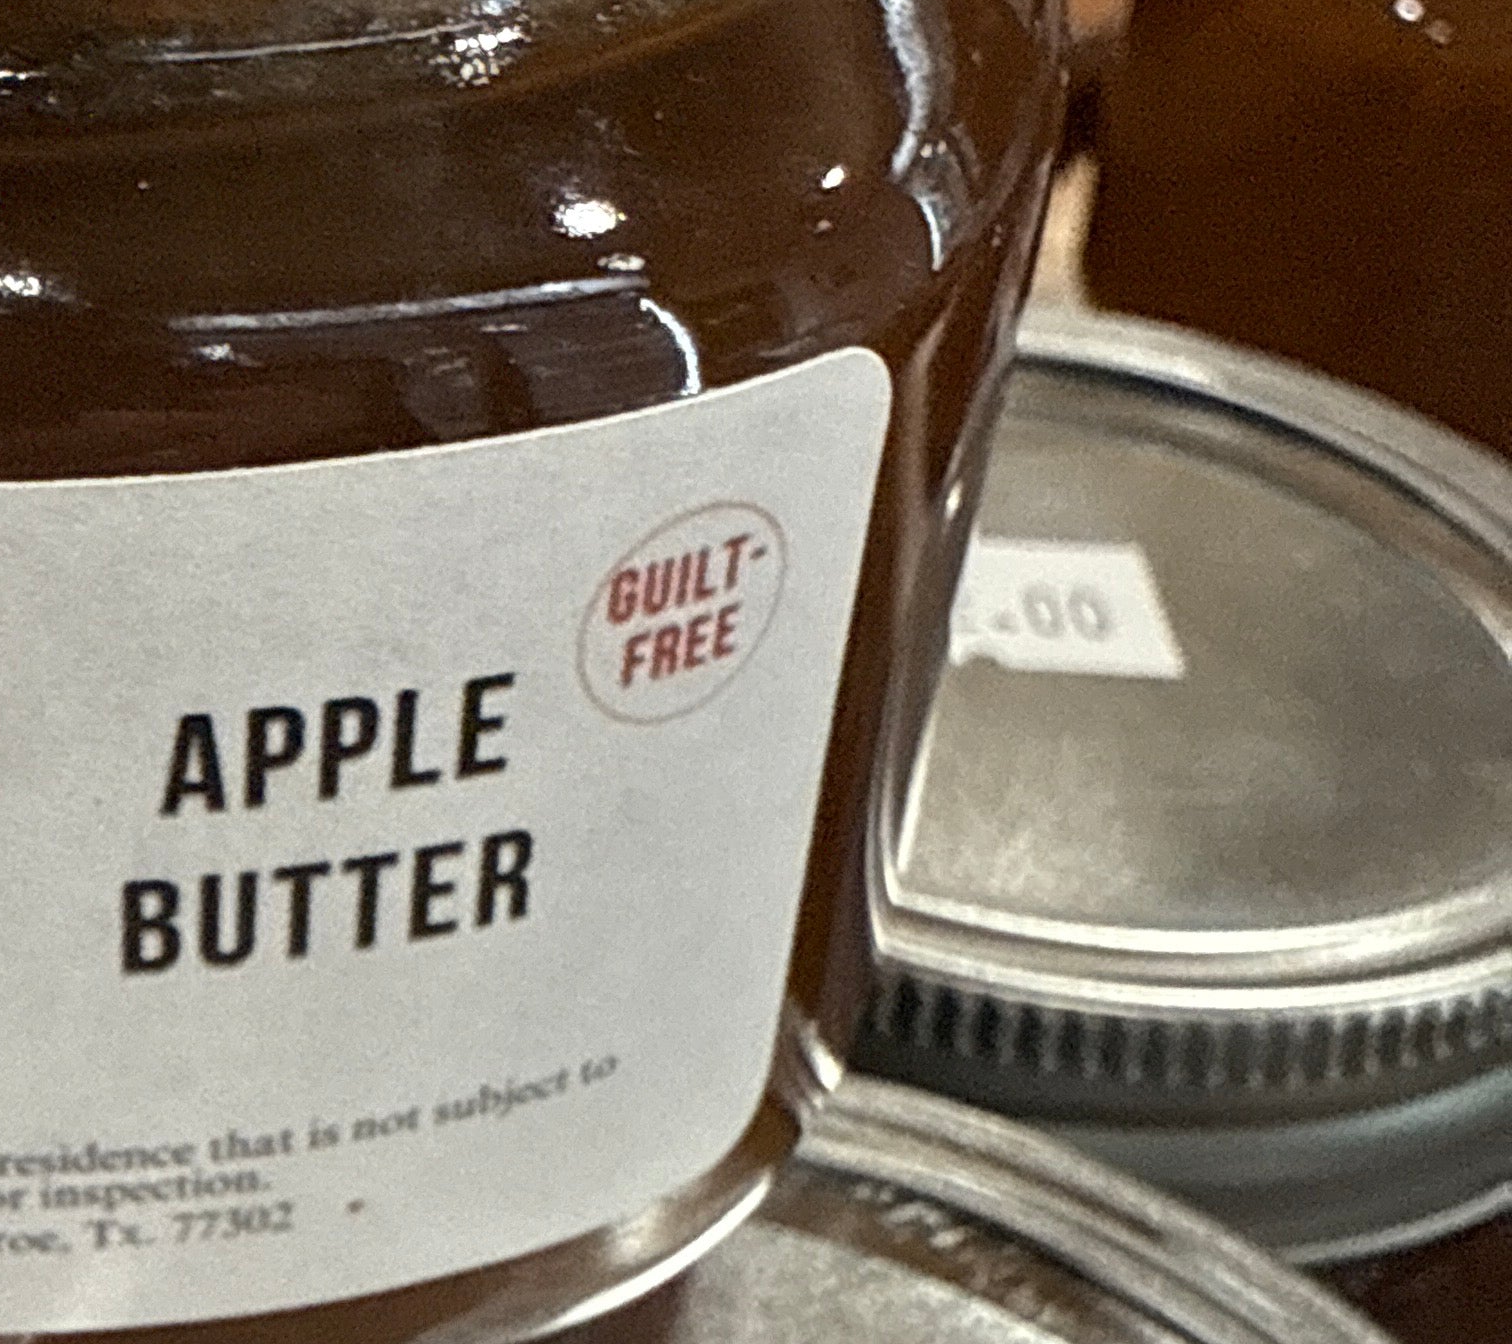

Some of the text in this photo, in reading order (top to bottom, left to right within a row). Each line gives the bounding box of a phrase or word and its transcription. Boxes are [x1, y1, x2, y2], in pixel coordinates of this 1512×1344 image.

[604, 531, 768, 626] GUILT-
[991, 580, 1112, 642] .00
[619, 602, 744, 689] FREE
[159, 669, 517, 817] APPLE
[119, 827, 536, 977] BUTTER
[207, 1127, 294, 1164] that
[307, 1115, 340, 1151] is
[350, 1106, 421, 1142] not
[432, 1066, 570, 1125] subject
[578, 1054, 619, 1087] to
[37, 1164, 270, 1212] inspection.
[172, 1199, 296, 1245] 77302
